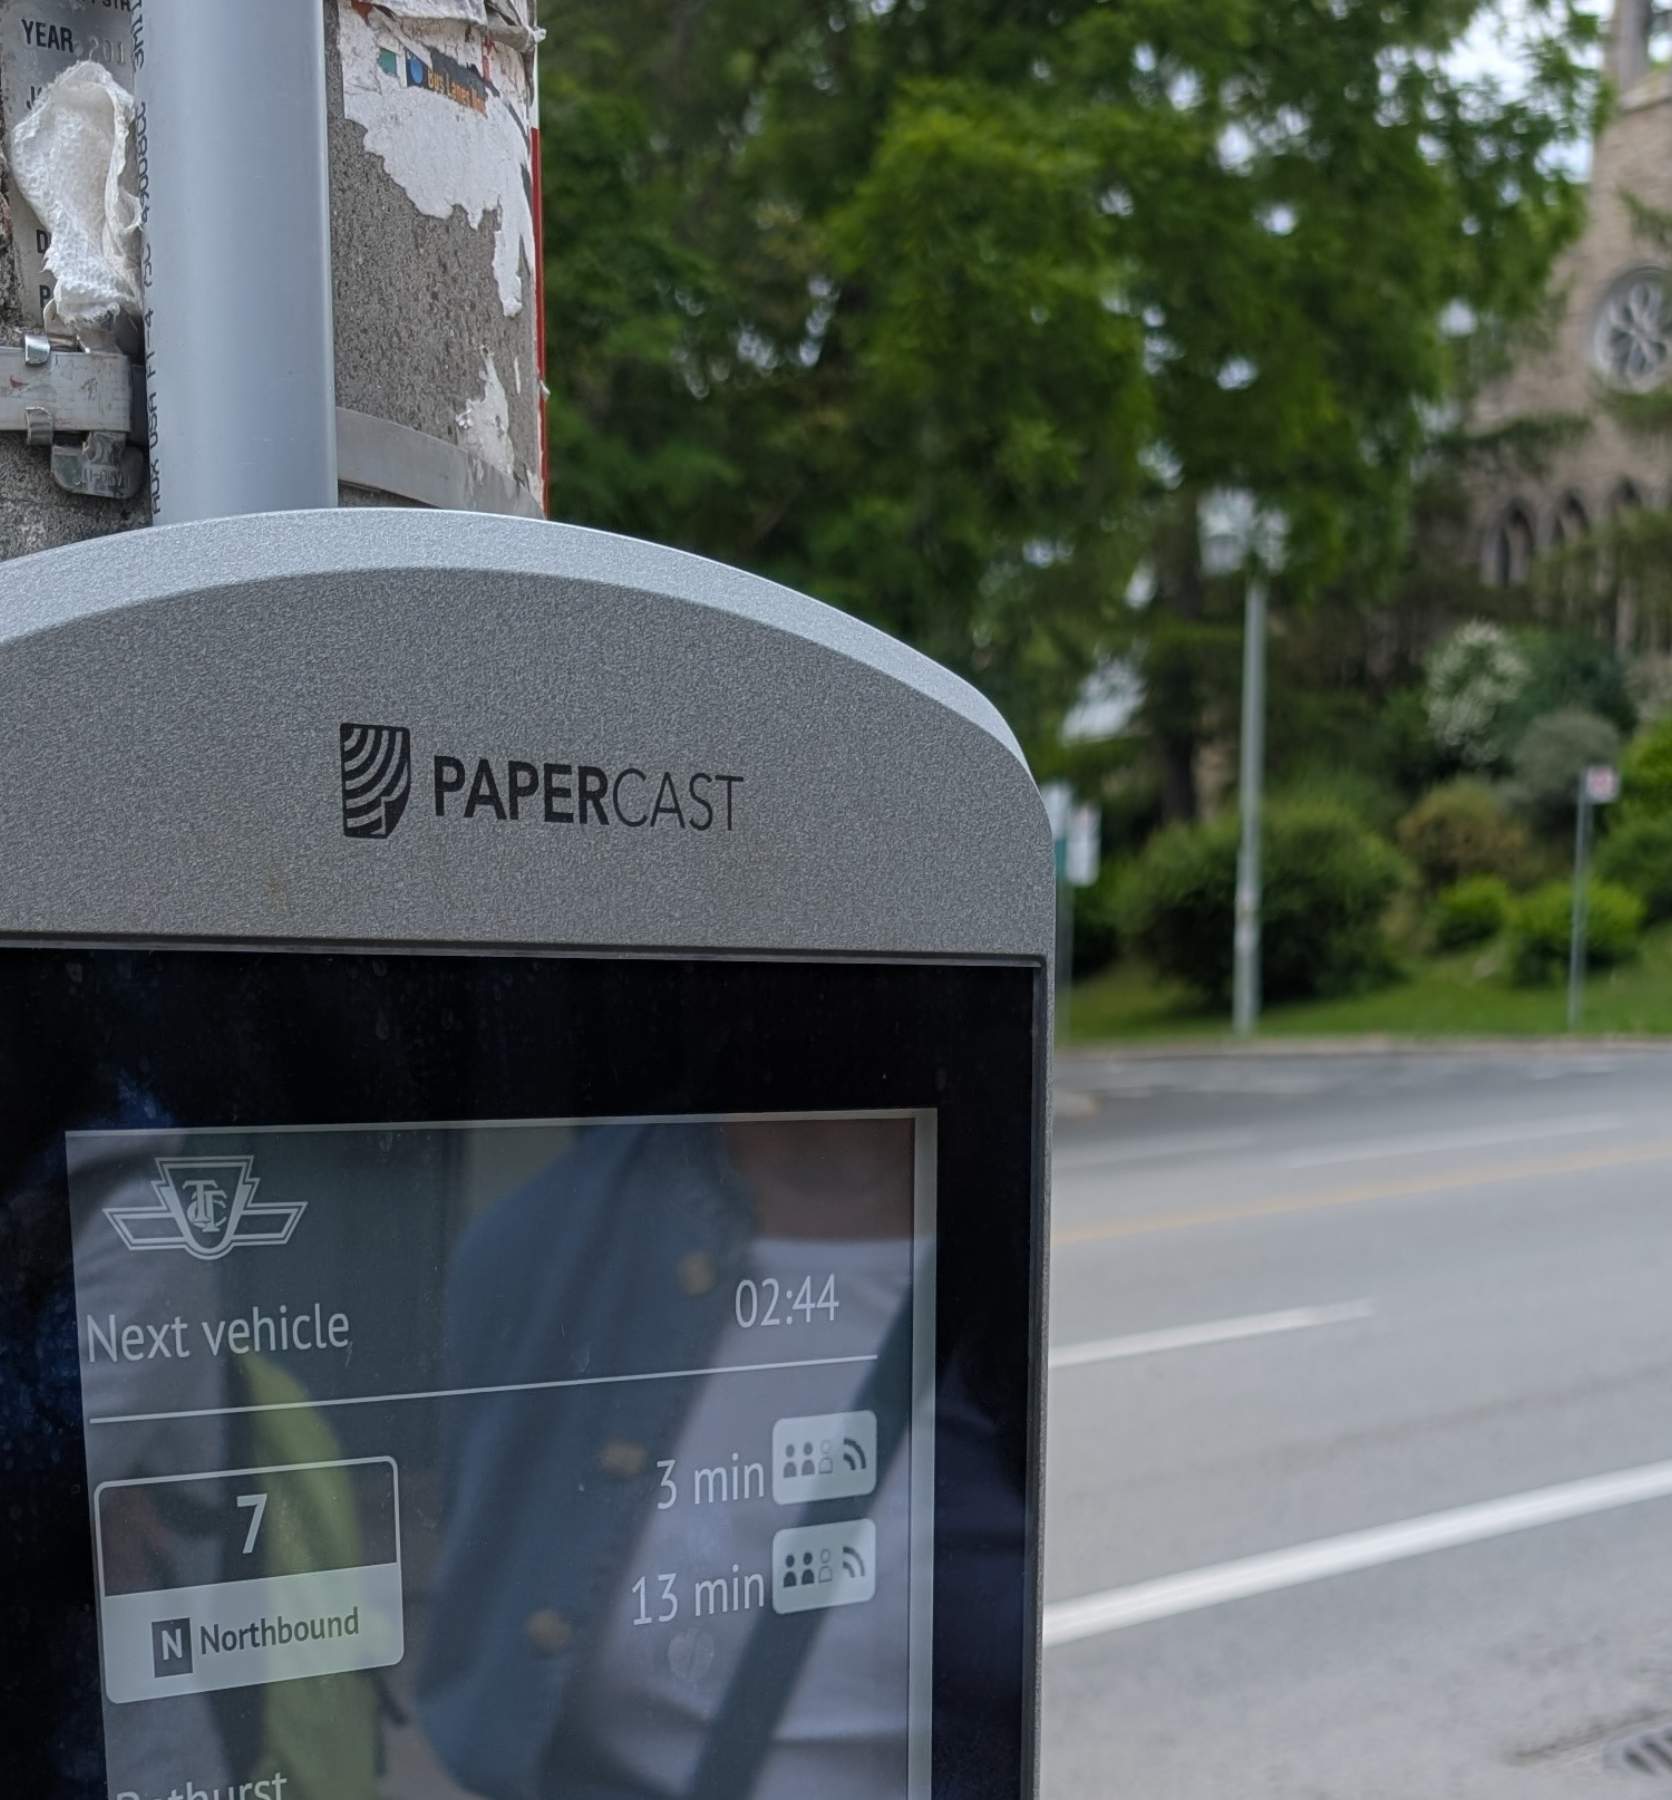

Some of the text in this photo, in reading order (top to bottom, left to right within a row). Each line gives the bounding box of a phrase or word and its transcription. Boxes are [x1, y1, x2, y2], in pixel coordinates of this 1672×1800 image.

[21, 19, 74, 53] YEAR
[433, 755, 744, 831] PAPERCAST
[734, 1273, 840, 1330] 02:44
[86, 1303, 351, 1363] Next vehicle
[657, 1453, 766, 1510] 3 min
[236, 1494, 268, 1555] 7
[631, 1565, 767, 1626] 13 min
[160, 1608, 359, 1662] N Northbound
